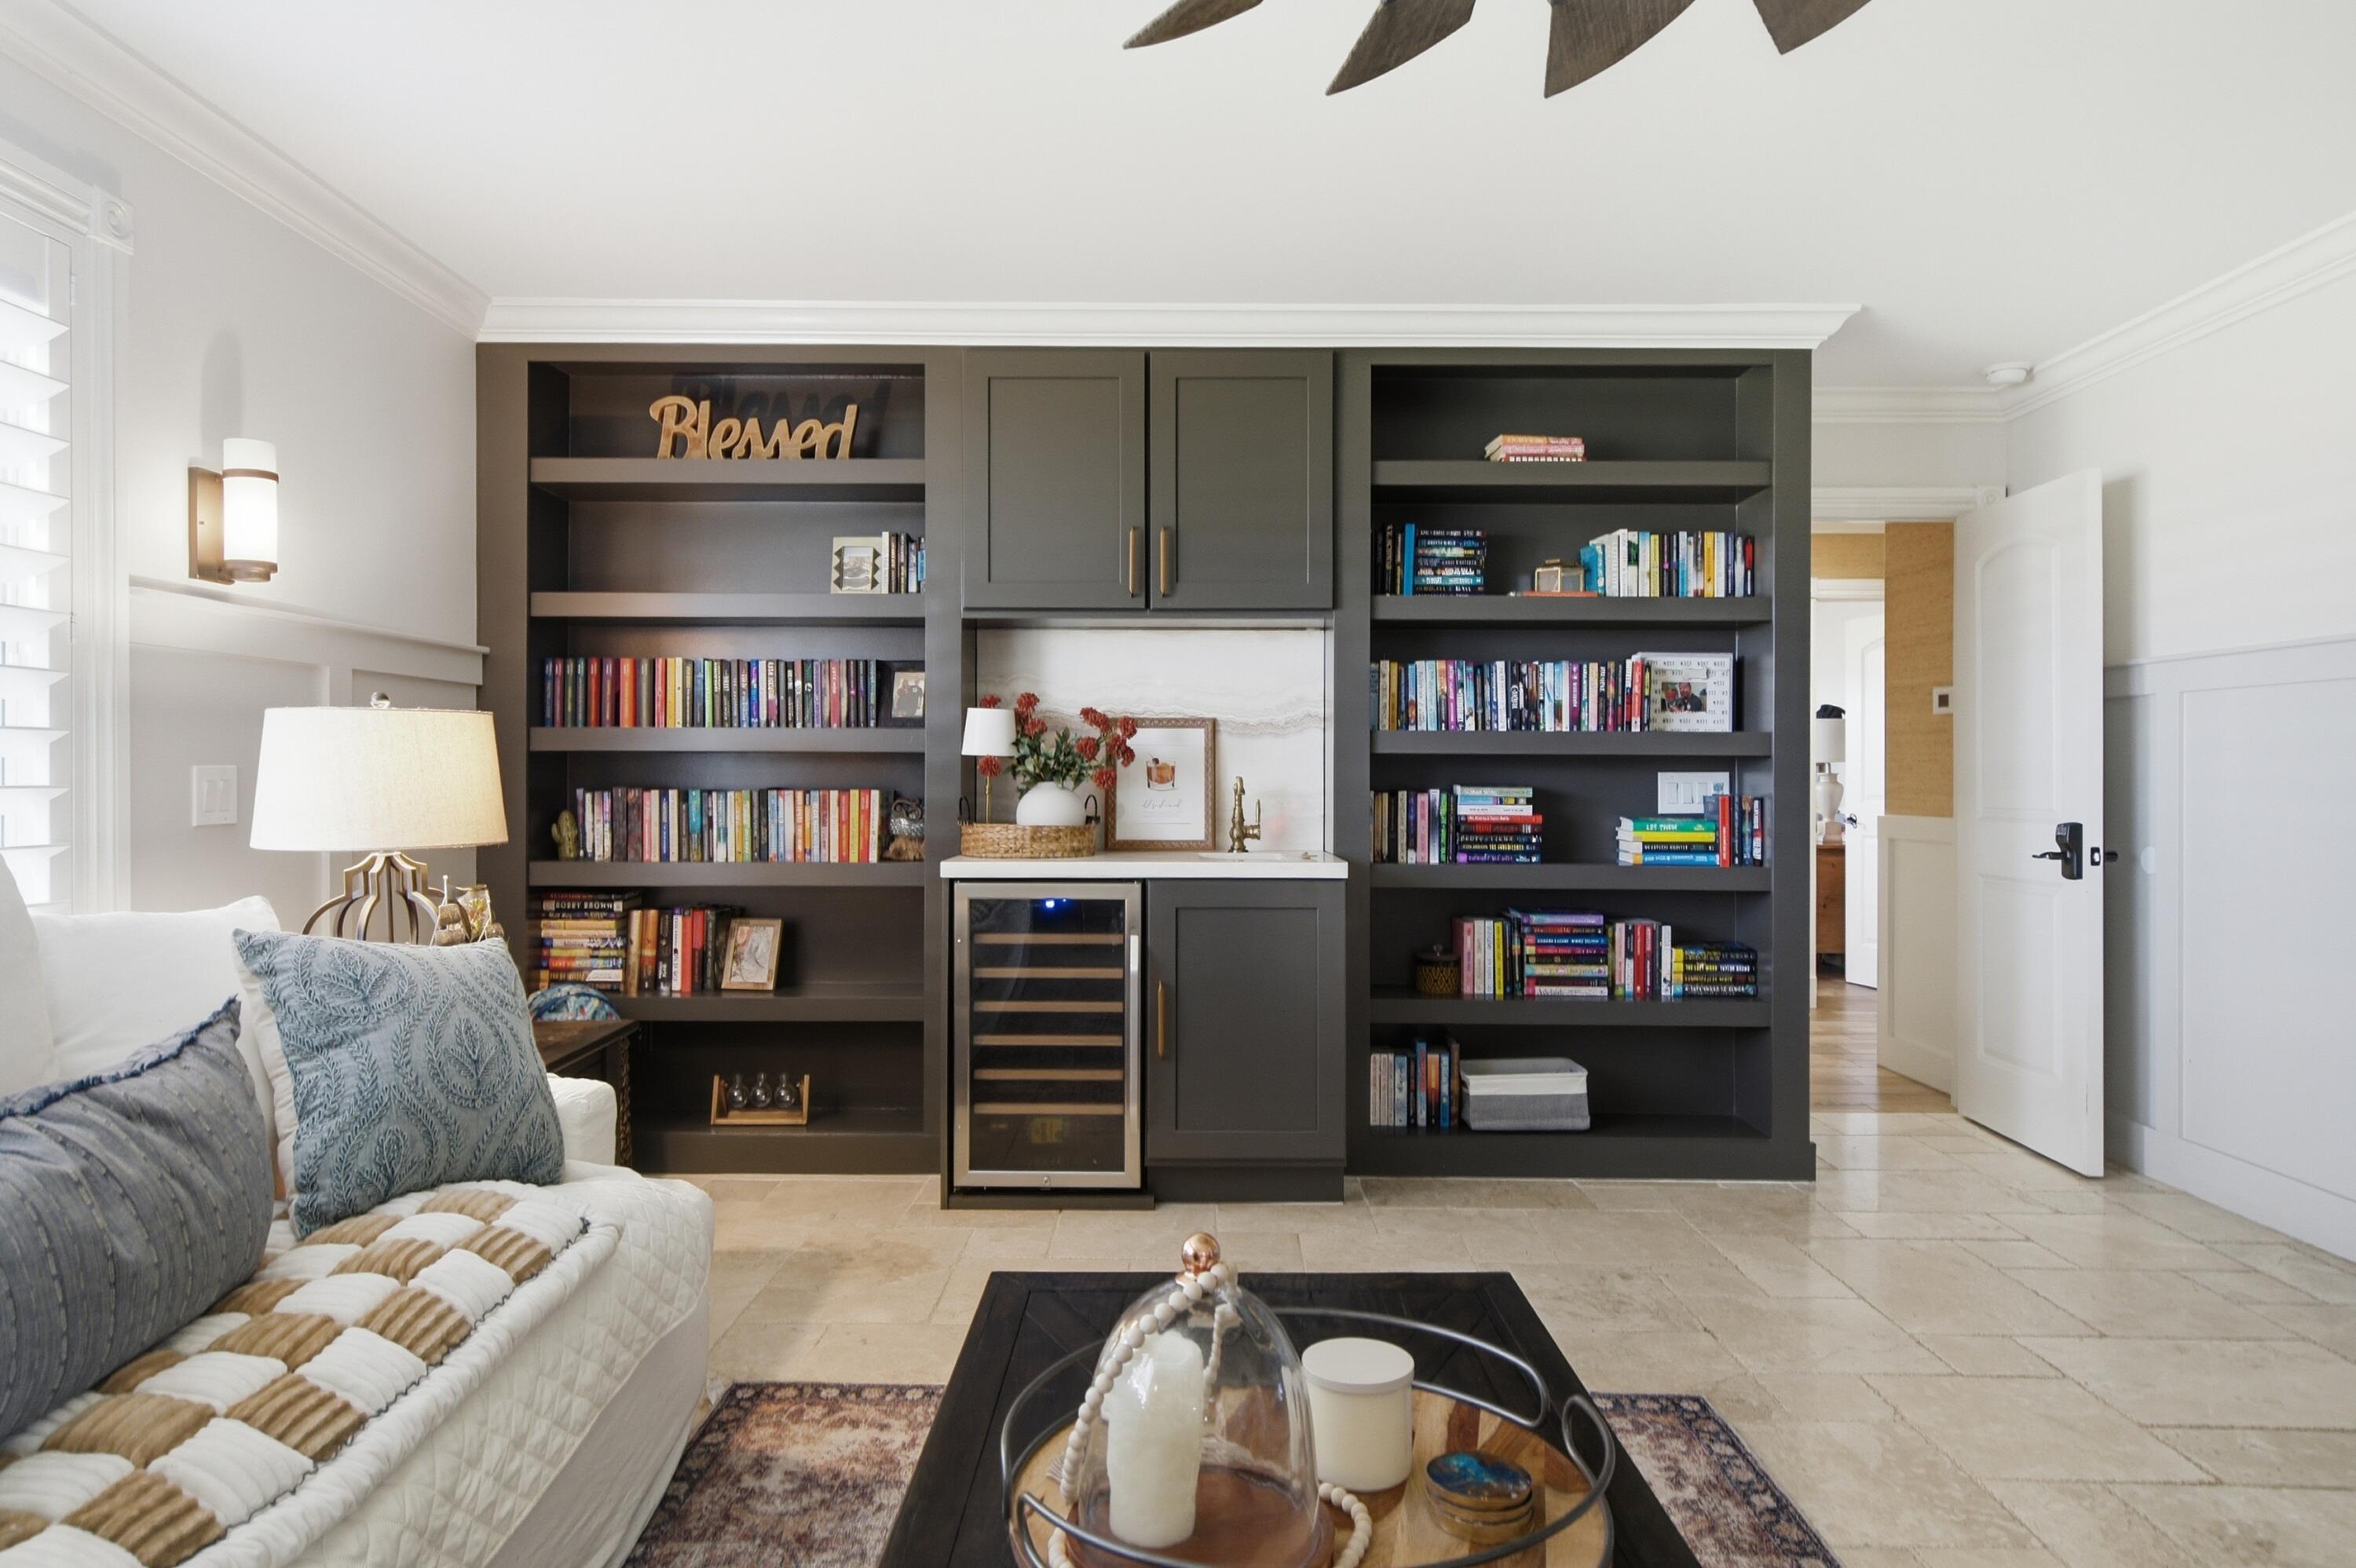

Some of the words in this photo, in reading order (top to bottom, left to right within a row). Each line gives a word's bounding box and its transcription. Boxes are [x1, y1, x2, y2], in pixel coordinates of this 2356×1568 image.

[649, 395, 858, 459] Blessed
[556, 901, 581, 909] BOBBY
[584, 901, 613, 911] BROWN
